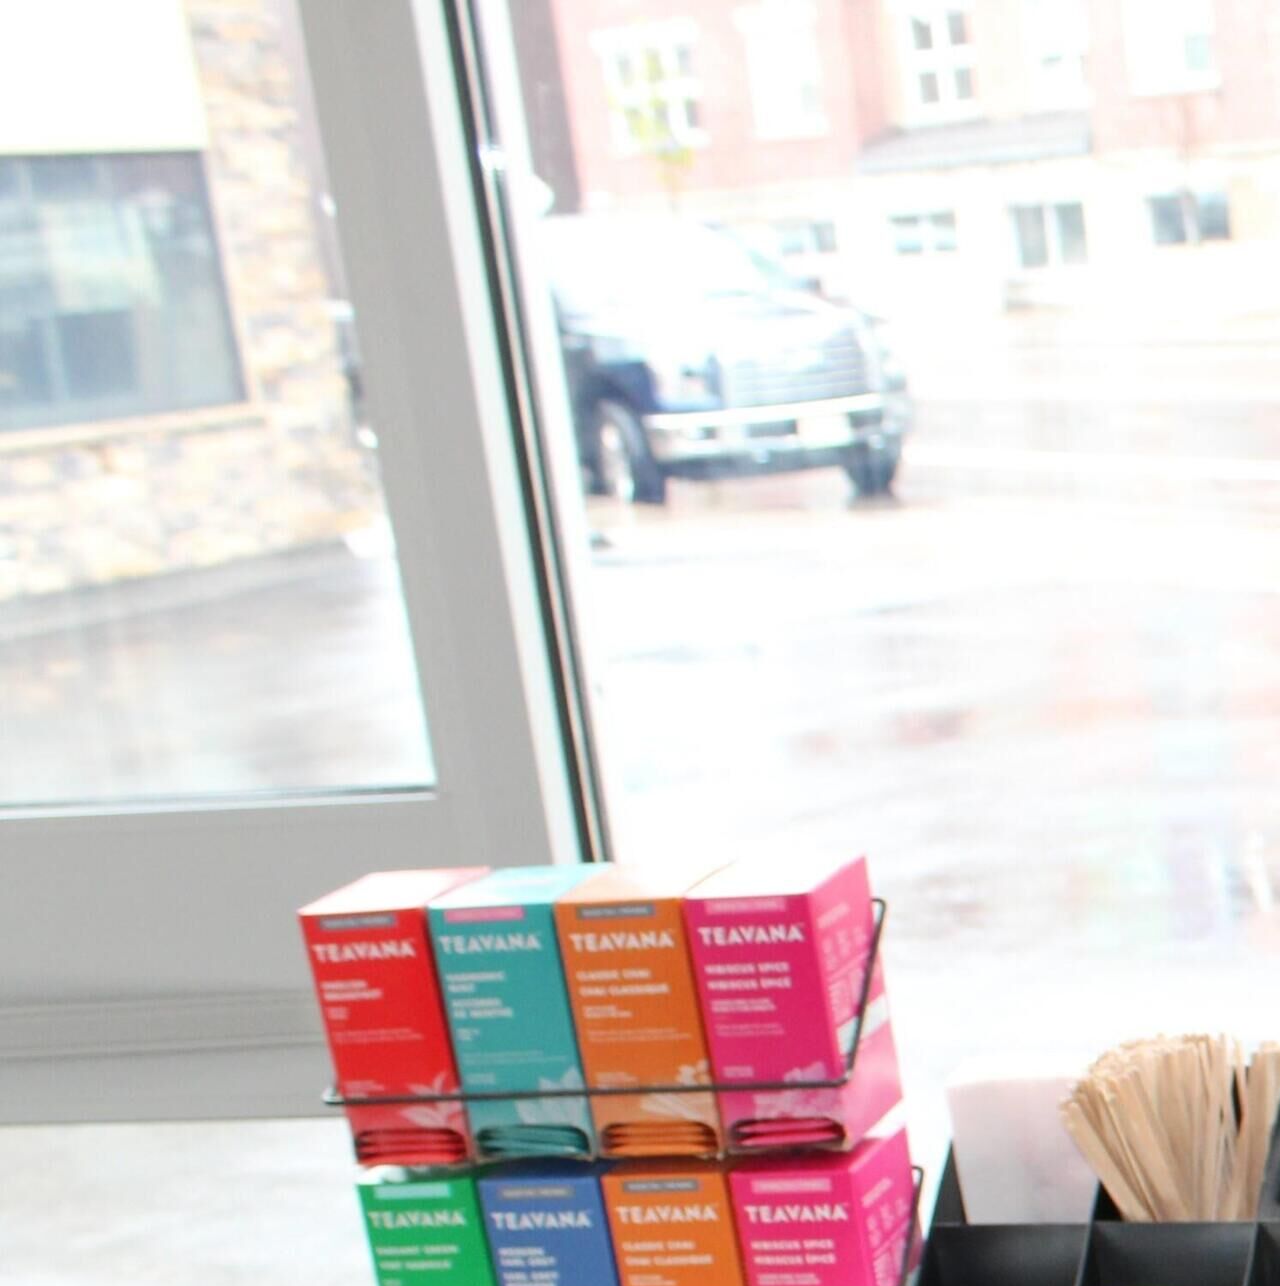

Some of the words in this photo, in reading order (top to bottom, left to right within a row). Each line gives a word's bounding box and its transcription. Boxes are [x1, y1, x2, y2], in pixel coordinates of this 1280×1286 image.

[438, 933, 541, 954] TEAVANA
[569, 931, 675, 952] TEAVANA
[698, 924, 804, 946] TEAVANA
[313, 940, 416, 962] TEAVANA
[367, 1209, 466, 1229] TEAVANA
[490, 1211, 592, 1229] TEAVANA
[616, 1205, 719, 1224] TEAVANA
[743, 1204, 848, 1223] TEAVANA
